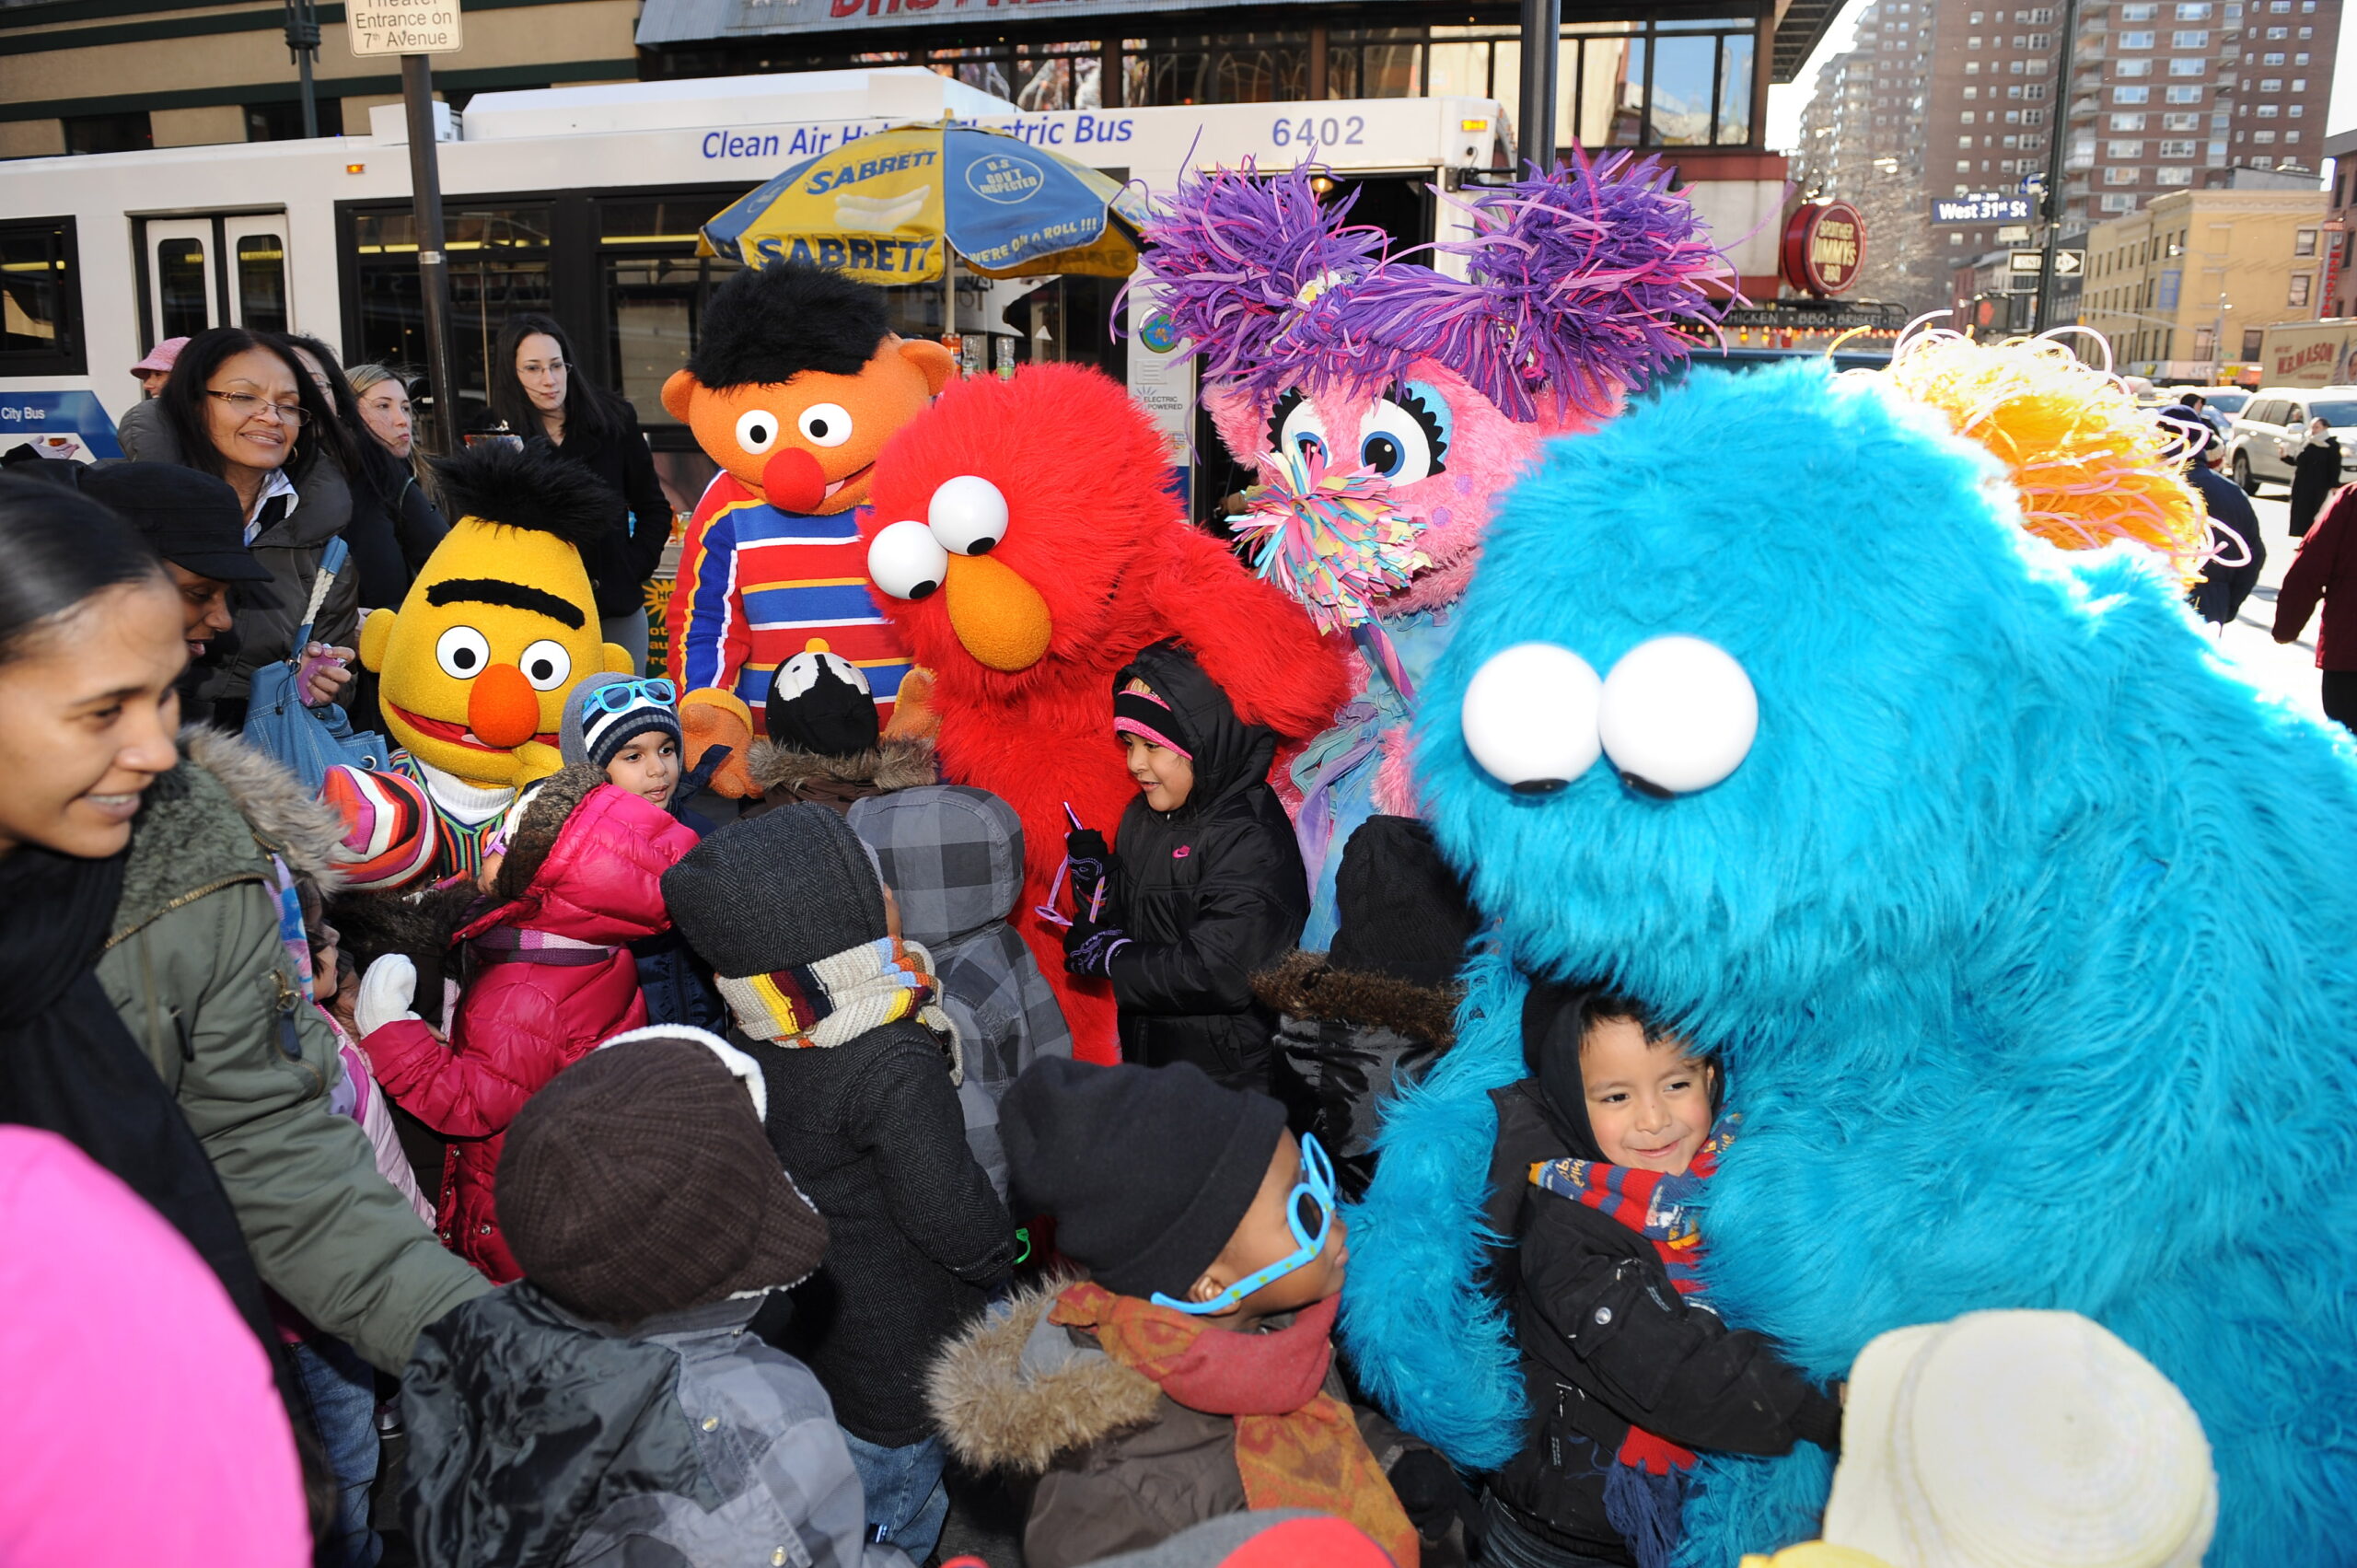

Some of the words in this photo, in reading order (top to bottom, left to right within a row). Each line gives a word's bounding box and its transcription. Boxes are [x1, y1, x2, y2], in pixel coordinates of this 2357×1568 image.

[355, 12, 427, 29] Entrance
[432, 11, 452, 25] on
[386, 30, 447, 47] Avenue
[1074, 115, 1133, 144] Bus
[1272, 115, 1364, 146] 6402
[702, 130, 780, 158] Clean
[788, 127, 831, 155] Air
[804, 150, 937, 195] SABRETT
[979, 176, 1038, 194] INSPECTED
[1939, 203, 1979, 220] West
[1980, 201, 2008, 218] 31st
[2010, 200, 2027, 218] St
[969, 244, 1009, 262] WE'RE
[1011, 235, 1028, 251] ON
[1042, 221, 1077, 239] ROLL
[1081, 217, 1097, 232] !!!
[1817, 219, 1854, 240] BROTHER
[754, 233, 936, 273] SABRETT
[1811, 236, 1857, 267] JIMMY'S
[1798, 312, 1827, 325] BBQ
[1, 406, 22, 423] City
[23, 406, 46, 420] Bus
